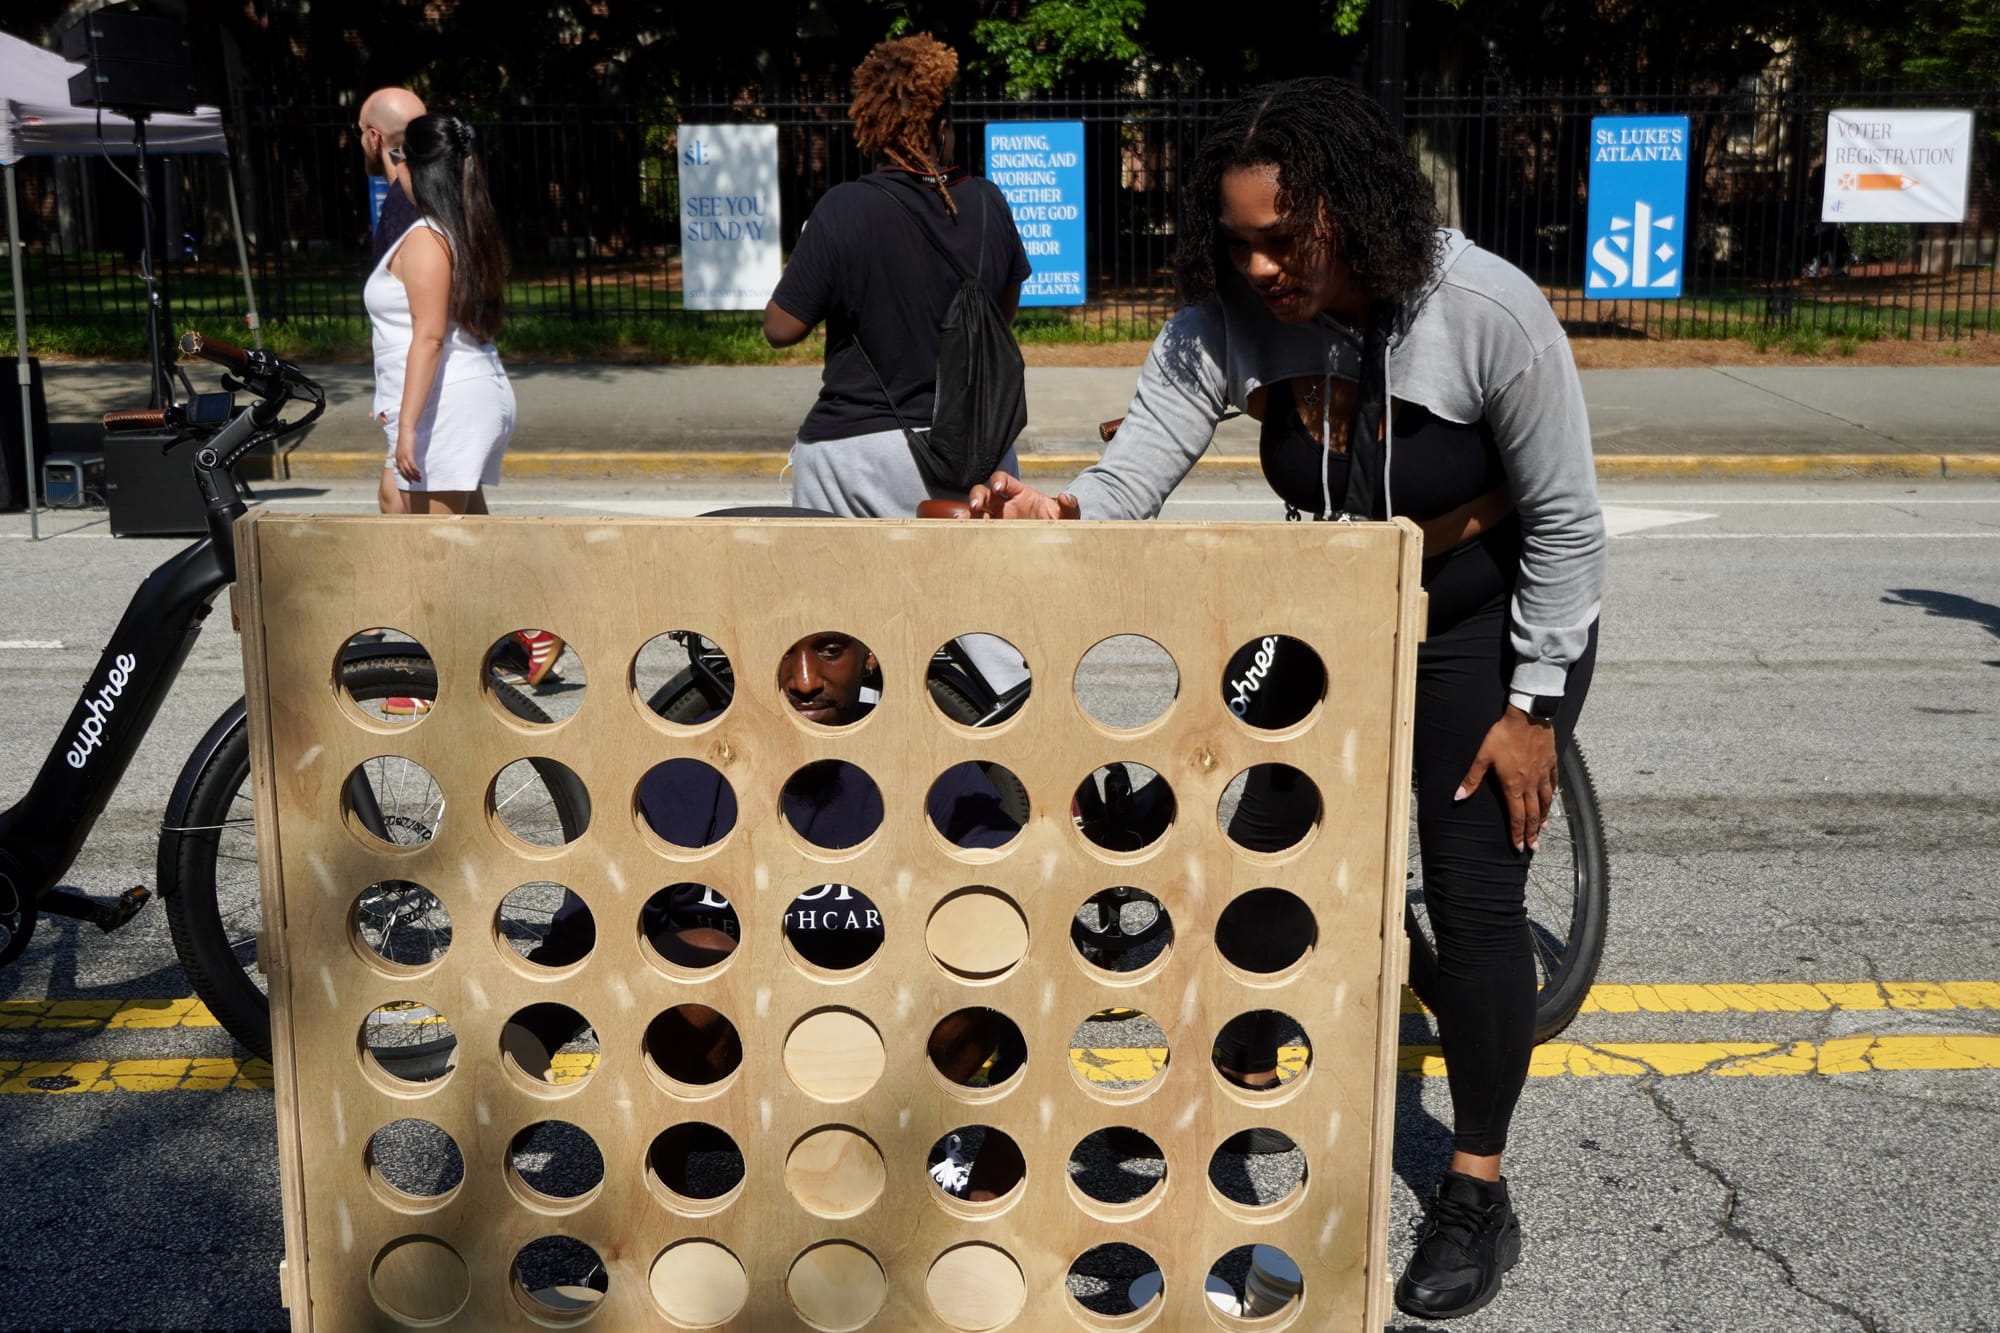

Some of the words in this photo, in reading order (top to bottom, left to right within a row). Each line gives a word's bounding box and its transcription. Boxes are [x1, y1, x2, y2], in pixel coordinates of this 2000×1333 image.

[1596, 129, 1617, 145] St.
[1621, 128, 1682, 144] LUKE'S
[1838, 122, 1892, 139] VOTER
[991, 135, 1049, 151] PRAYING,
[991, 153, 1047, 169] SINGING,
[1048, 152, 1077, 168] AND
[1595, 146, 1682, 162] ATLANTA
[1836, 147, 1954, 165] REGISTRATION
[992, 170, 1056, 186] WORKING
[1000, 188, 1061, 203] OGETHER
[687, 197, 721, 217] SEE
[727, 196, 766, 217] YOU
[1012, 206, 1046, 220] LOVE
[1047, 206, 1077, 220] GOD
[687, 221, 765, 242] SUNDAY
[1022, 223, 1051, 238] OUR
[1023, 241, 1060, 256] HBOR
[1038, 272, 1080, 283] LUKE'S
[1021, 284, 1080, 295] ATLANTA
[1229, 636, 1278, 718] phree
[66, 653, 136, 769] euphree
